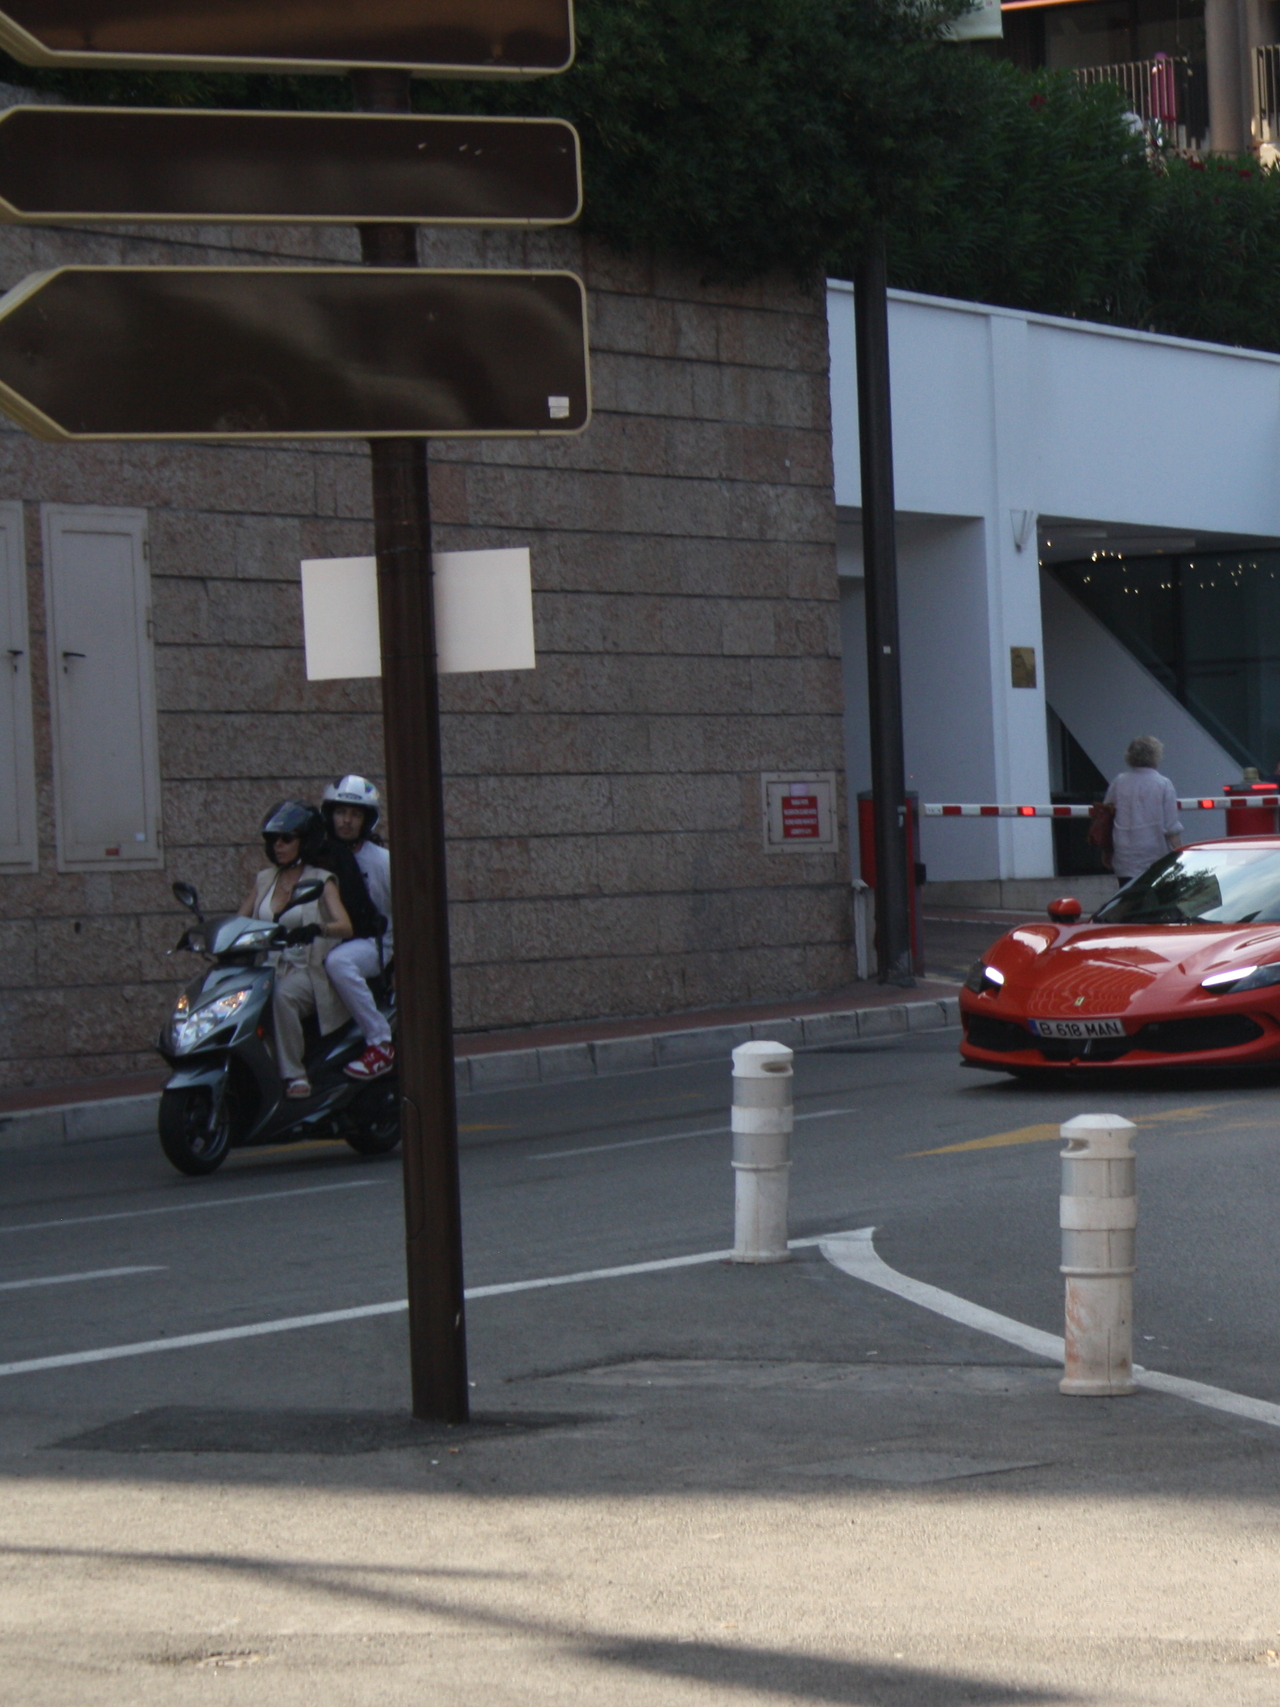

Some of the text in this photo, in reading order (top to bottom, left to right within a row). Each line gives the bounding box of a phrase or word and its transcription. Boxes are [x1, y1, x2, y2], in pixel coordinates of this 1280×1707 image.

[1039, 1021, 1120, 1037] B 618 MAN
